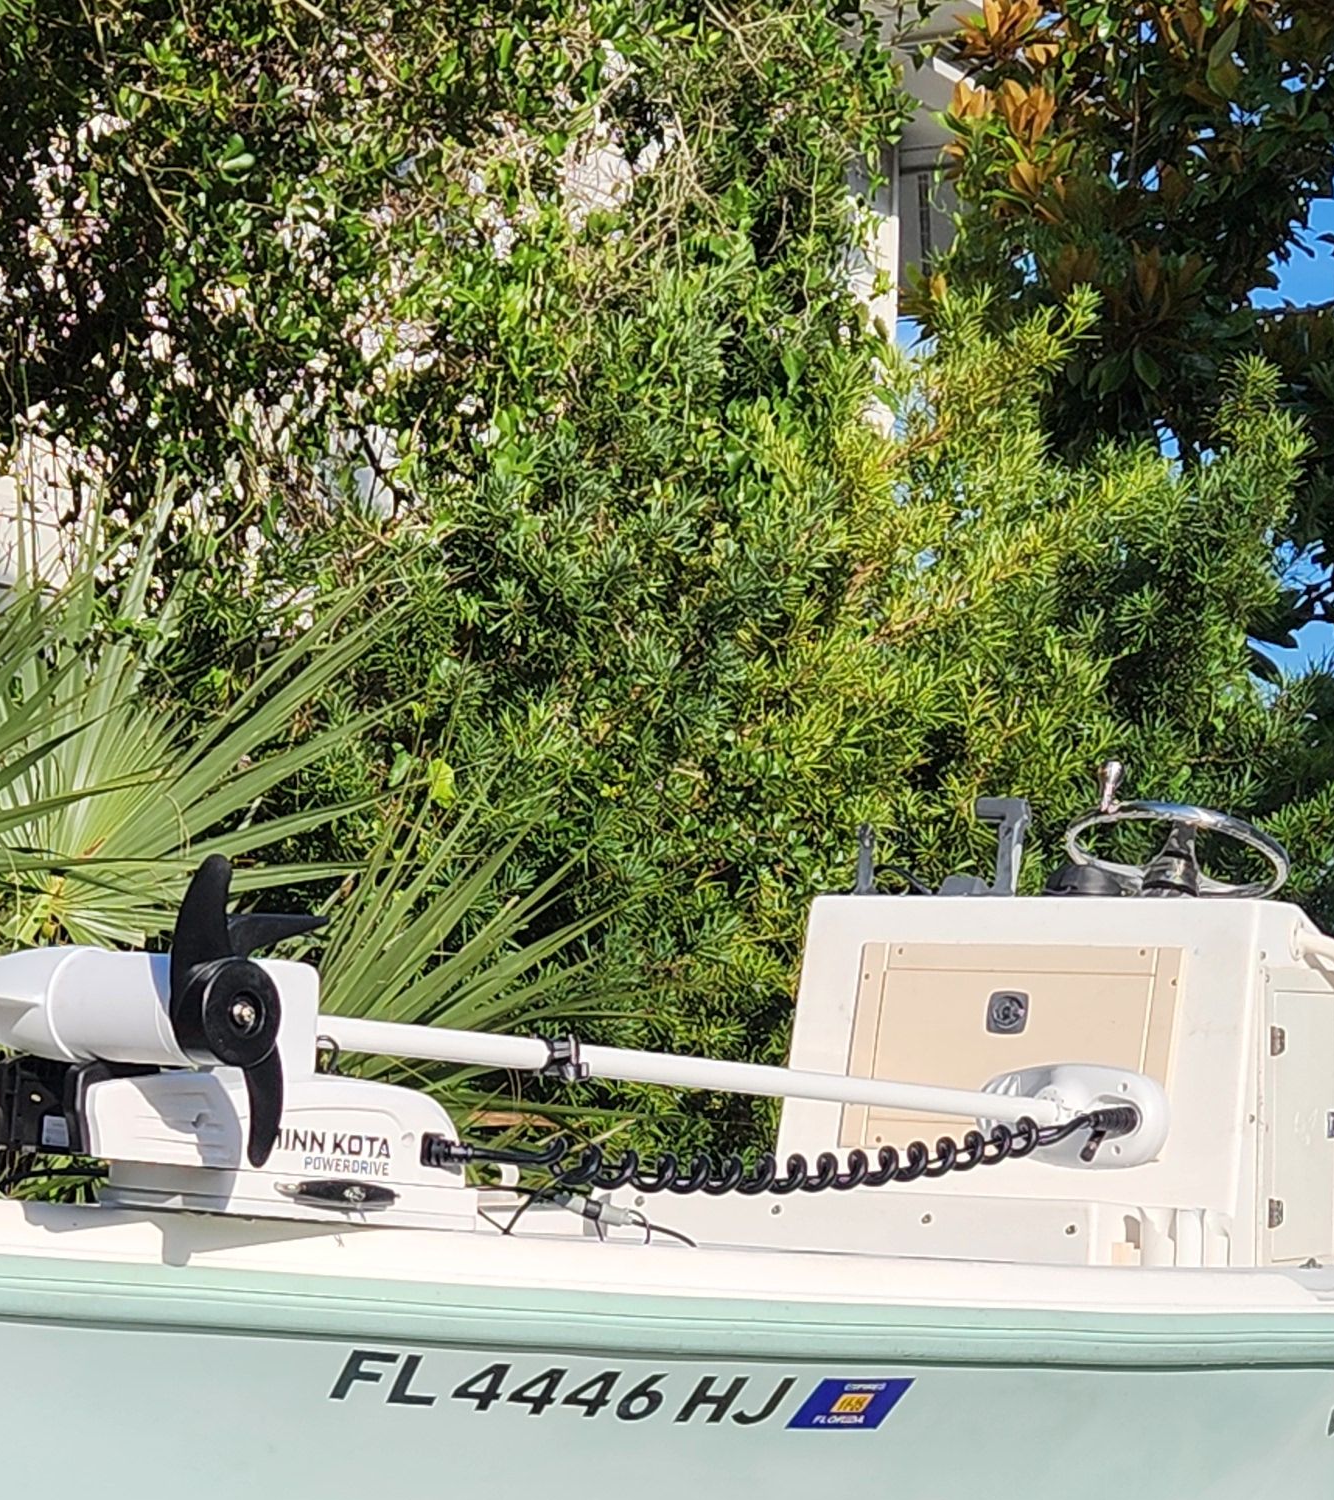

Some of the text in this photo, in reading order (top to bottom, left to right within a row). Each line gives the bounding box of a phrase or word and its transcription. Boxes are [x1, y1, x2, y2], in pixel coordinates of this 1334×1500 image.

[331, 1132, 391, 1160] KOTA
[304, 1156, 389, 1177] POWERDRIVE
[327, 1348, 798, 1426] FL 4446 HJ
